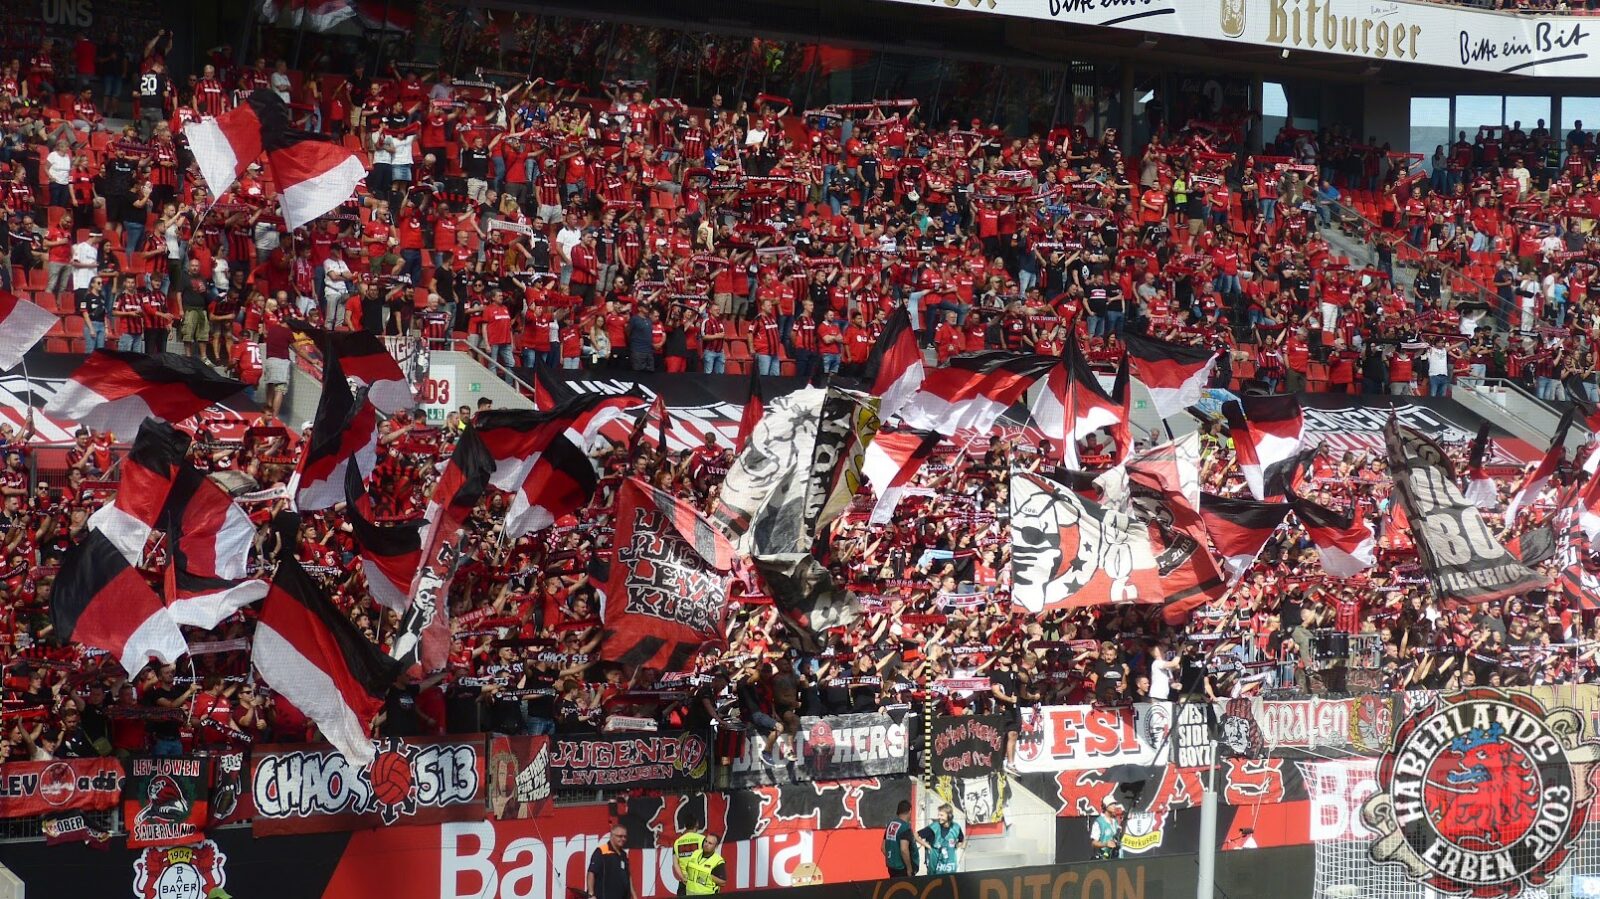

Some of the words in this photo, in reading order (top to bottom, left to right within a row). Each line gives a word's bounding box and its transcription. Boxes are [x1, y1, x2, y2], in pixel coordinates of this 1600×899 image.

[1265, 0, 1421, 60] Bitburger
[1459, 30, 1498, 65] Bitte
[1502, 36, 1531, 57] ein
[1535, 22, 1590, 52] Bit
[140, 77, 158, 92] 20
[537, 651, 569, 663] CHAOS
[572, 653, 589, 663] 513
[1049, 707, 1141, 760] FSI
[1178, 724, 1210, 747] SIDE
[550, 736, 681, 769] JUGEND
[1178, 745, 1211, 768] BOYZ
[133, 758, 200, 777] LEV-LÖWEN
[561, 763, 673, 785] LEVERKUSEN
[253, 751, 371, 818] CHAOS
[416, 743, 479, 808] 513
[134, 822, 197, 841] SAUERLAND
[1124, 834, 1158, 847] everkusen
[170, 850, 190, 860] 1904
[162, 883, 197, 893] BAYER
